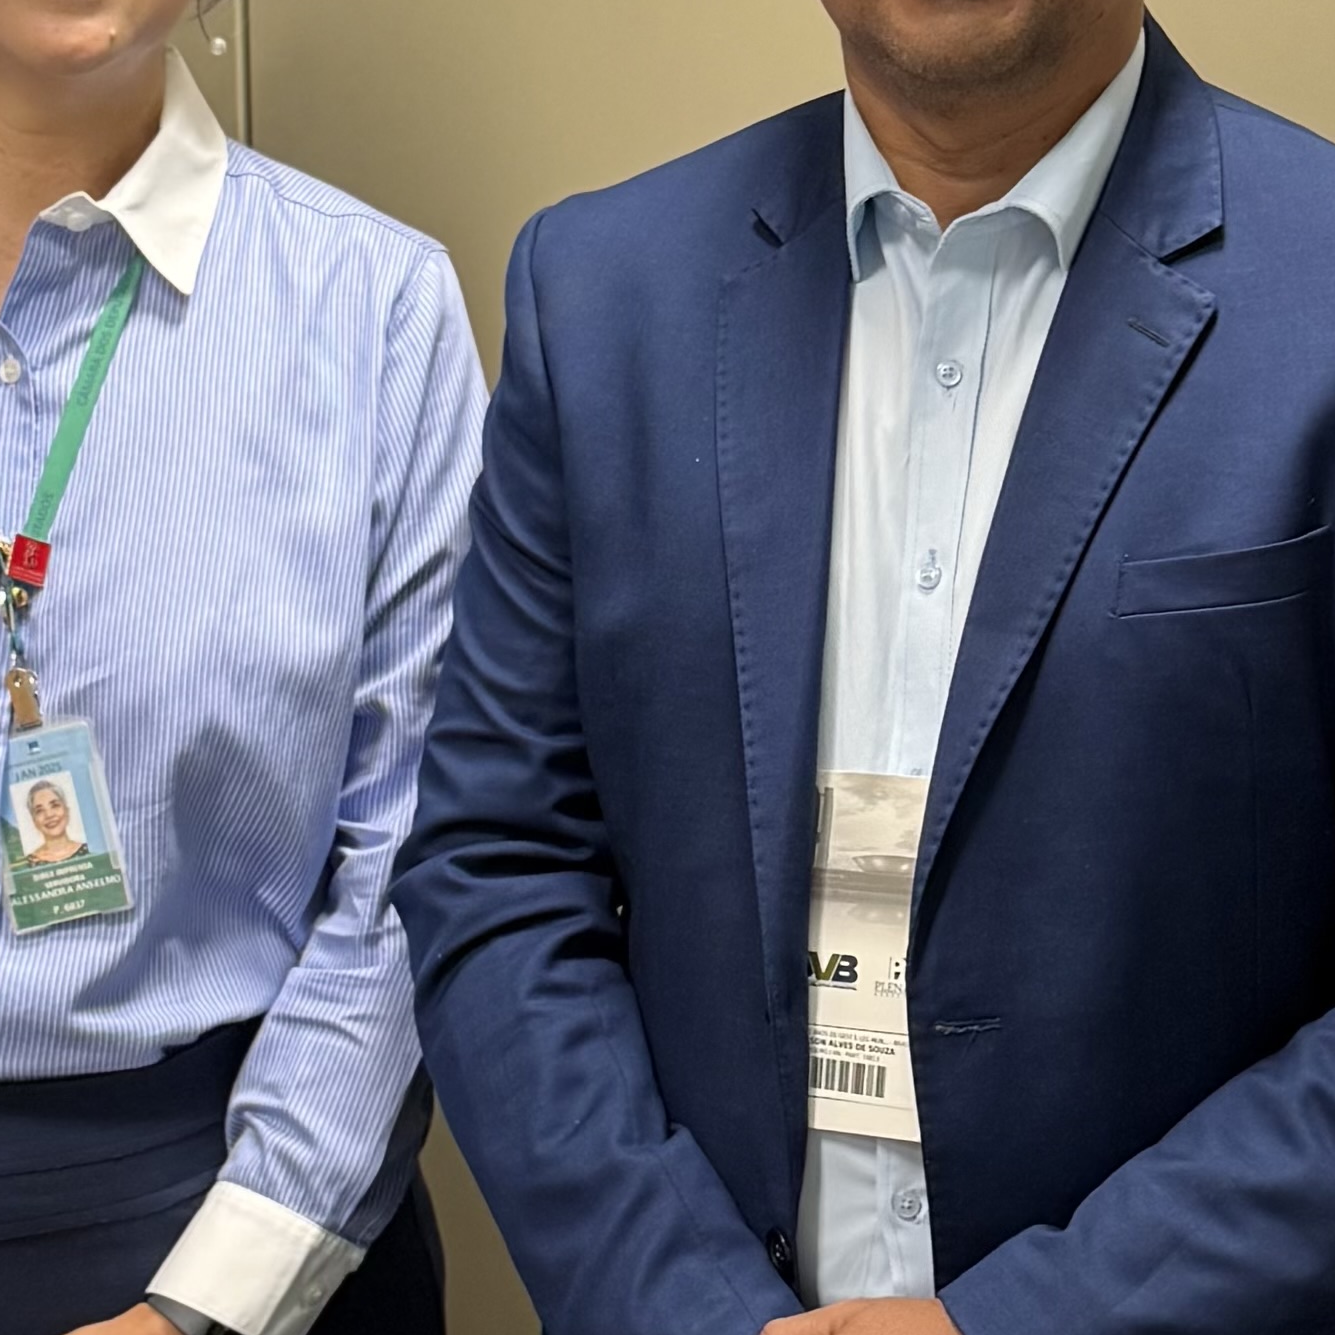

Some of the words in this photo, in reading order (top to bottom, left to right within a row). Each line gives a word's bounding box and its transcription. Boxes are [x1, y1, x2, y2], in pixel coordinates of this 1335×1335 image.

[15, 766, 37, 783] JAN
[12, 886, 75, 906] ALESSANDRA
[75, 873, 122, 892] ANSELMO
[829, 1040, 854, 1050] ALVES
[855, 1043, 866, 1052] DE
[868, 1044, 896, 1056] SOUZA
